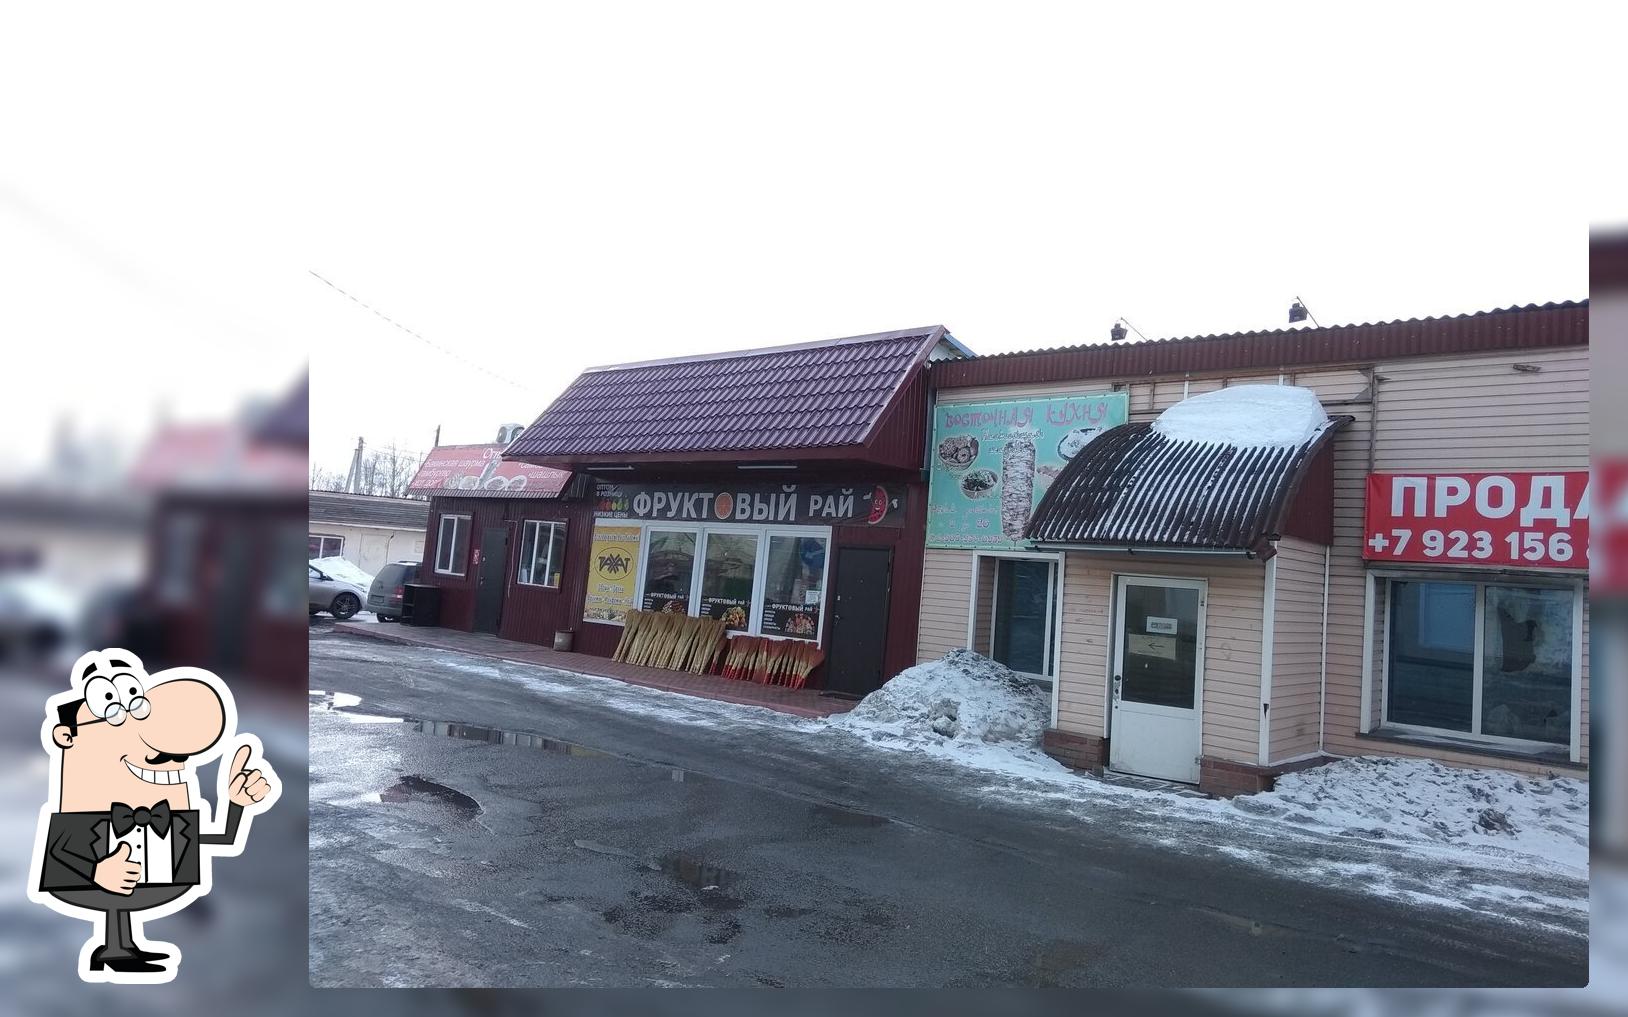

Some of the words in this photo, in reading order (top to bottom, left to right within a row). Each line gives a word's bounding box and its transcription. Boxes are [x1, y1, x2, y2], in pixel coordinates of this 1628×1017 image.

[1046, 401, 1109, 427] КУХНЯ
[632, 485, 798, 521] ФРУКТОВЫЙ
[808, 488, 854, 518] РАЙ
[1368, 529, 1413, 556] +7
[1422, 530, 1493, 559] 923
[1505, 532, 1574, 562] 156
[708, 597, 737, 605] ФРУКТОВЫЙ
[771, 603, 804, 612] ФРУКТОВЫЙ
